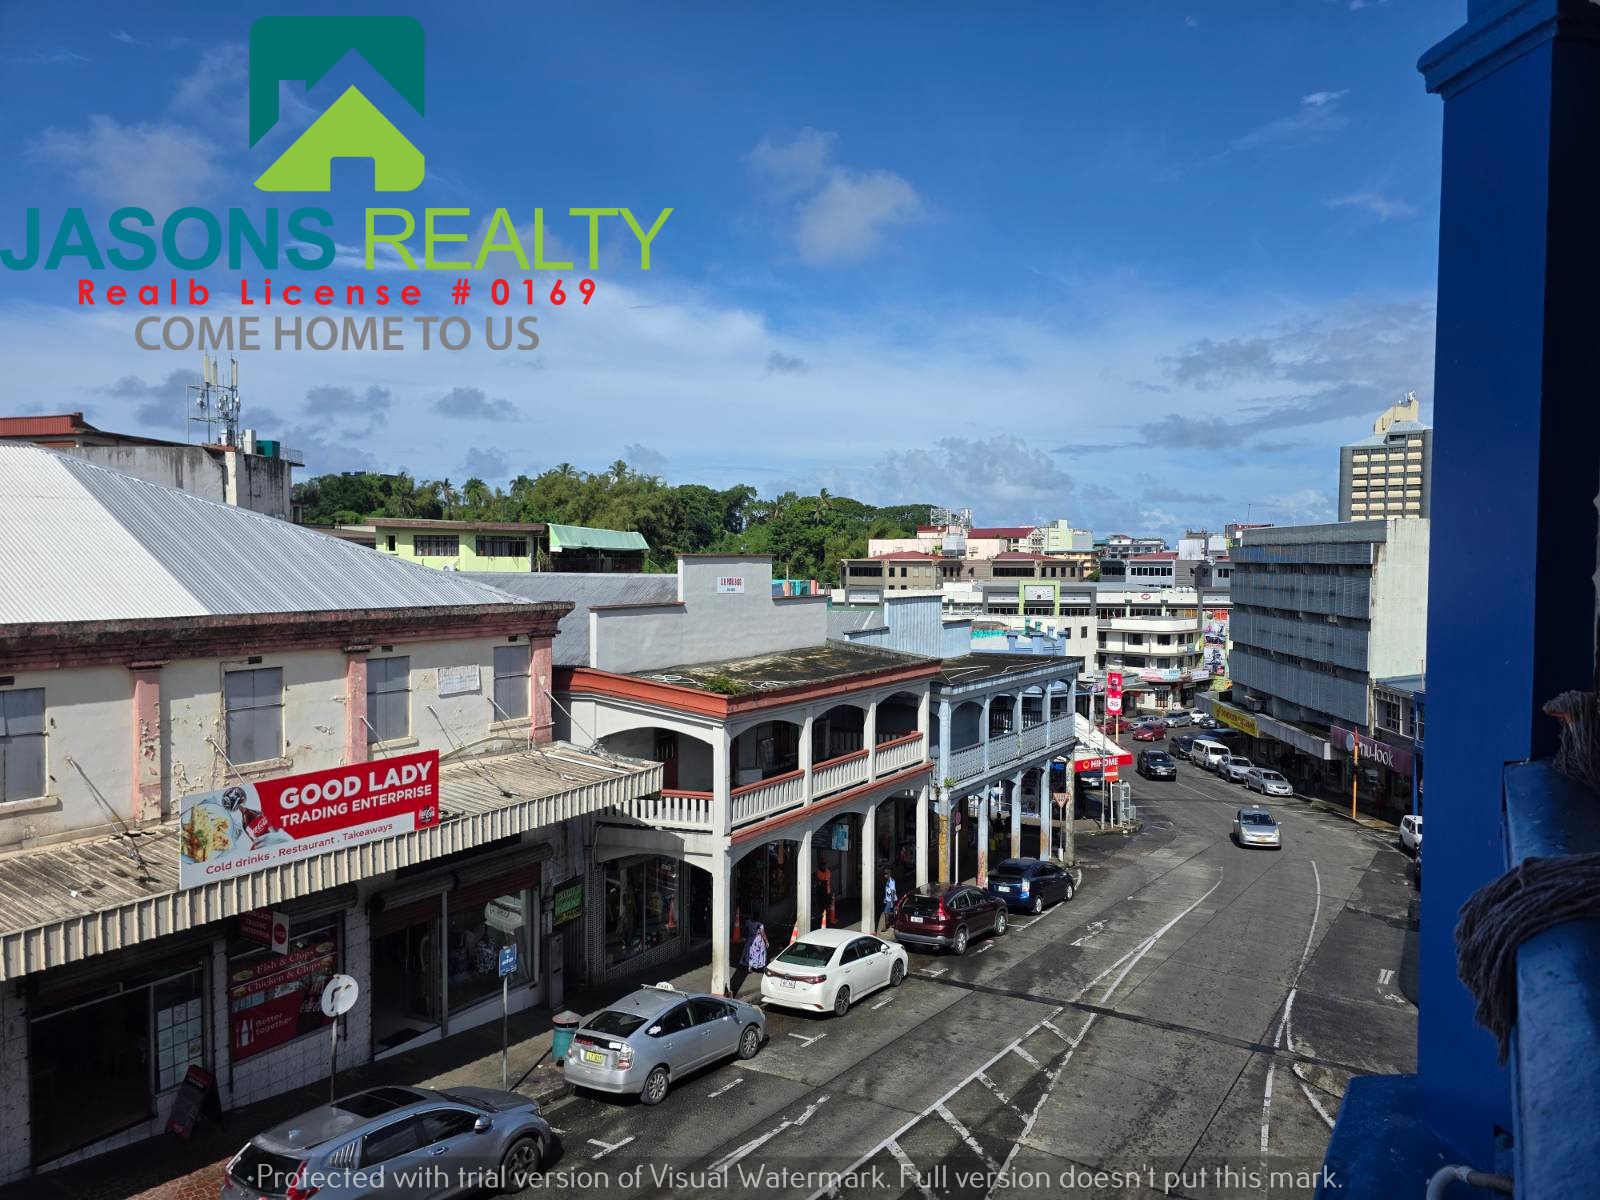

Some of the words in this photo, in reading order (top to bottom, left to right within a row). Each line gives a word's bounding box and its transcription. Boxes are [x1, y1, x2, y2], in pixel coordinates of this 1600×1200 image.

[280, 776, 362, 810] GOOD
[369, 760, 433, 792] LADY
[280, 803, 348, 828] TRADING
[352, 784, 432, 814] ENTERPRISE
[206, 861, 232, 875] Cold
[235, 853, 270, 869] drinks
[278, 836, 335, 857] Restaurant
[343, 822, 393, 842] Takeaways
[248, 974, 284, 992] Chicken
[257, 962, 277, 975] Fish
[289, 950, 314, 964] Chips
